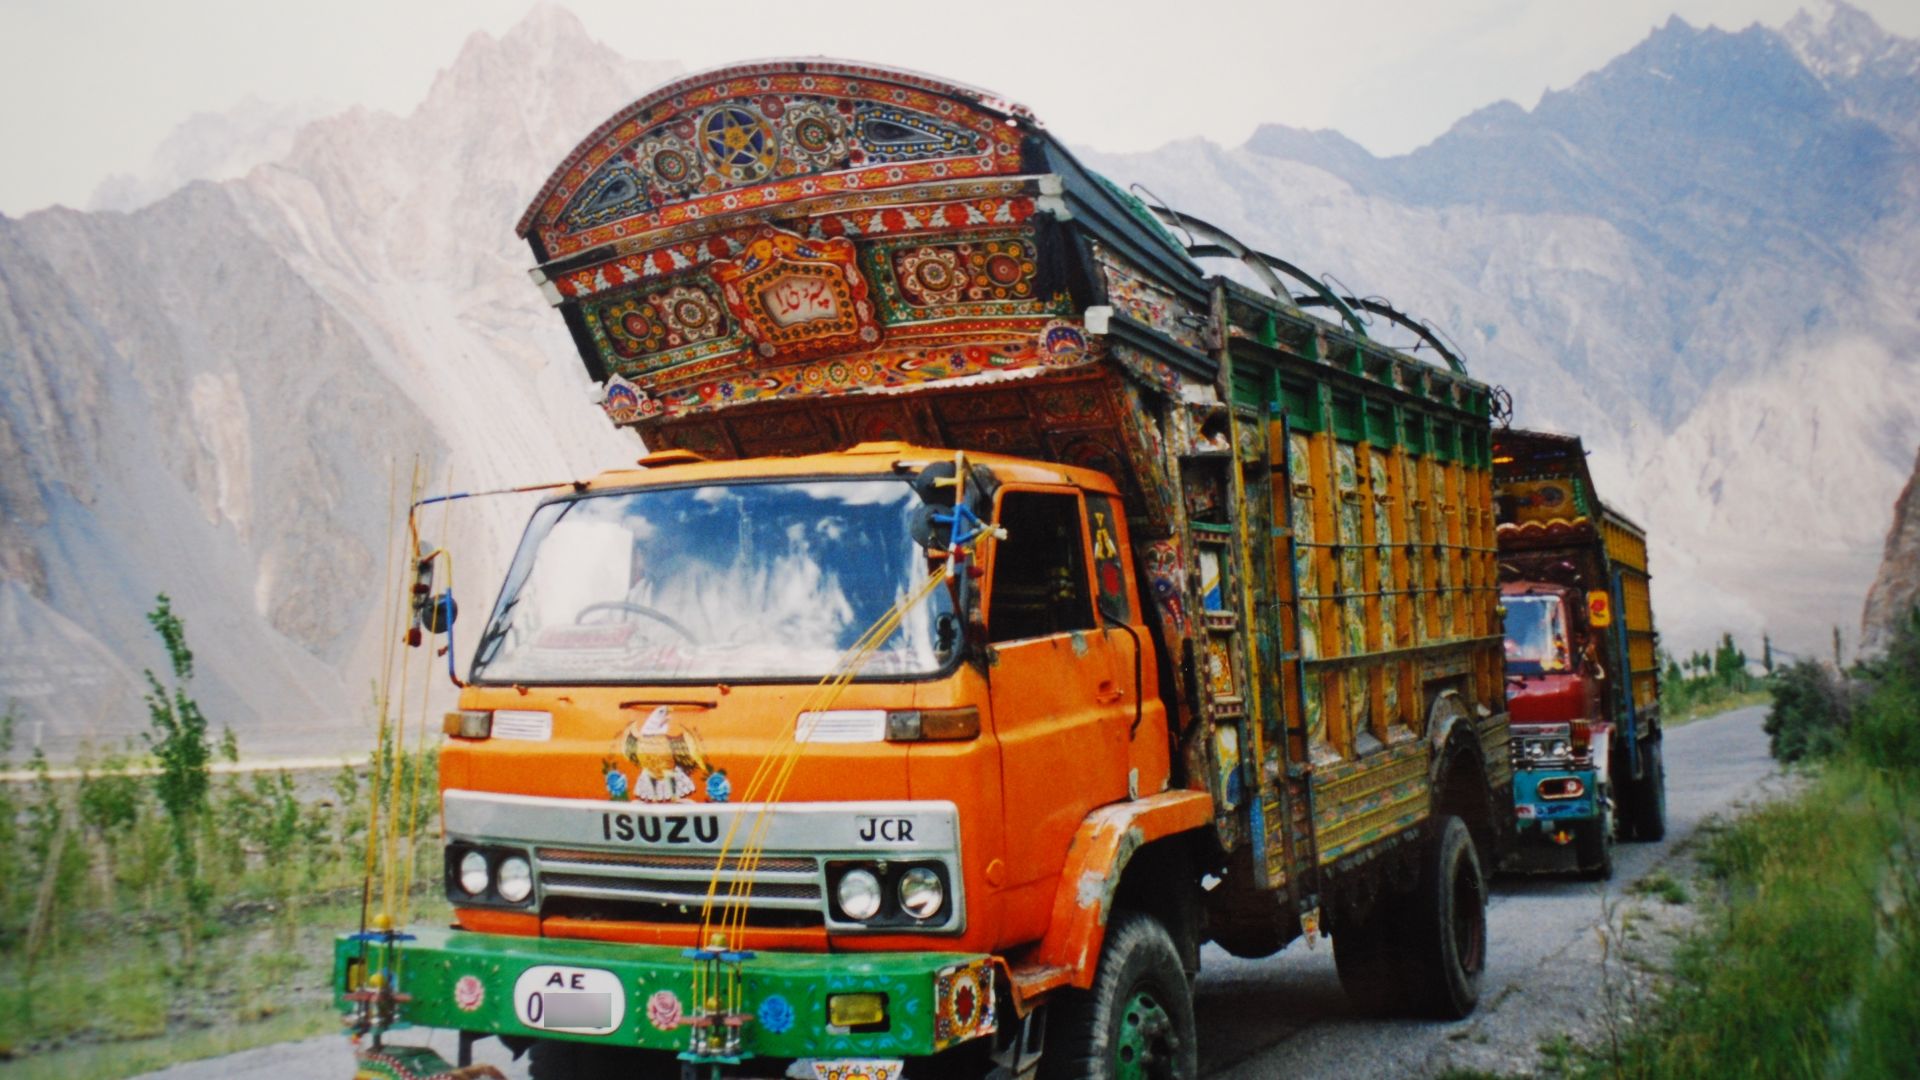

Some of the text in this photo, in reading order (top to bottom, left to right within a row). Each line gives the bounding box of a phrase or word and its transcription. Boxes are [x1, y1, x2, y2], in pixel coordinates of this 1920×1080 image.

[602, 812, 720, 844] ISUZU
[859, 818, 915, 842] JCR
[546, 972, 586, 990] AE
